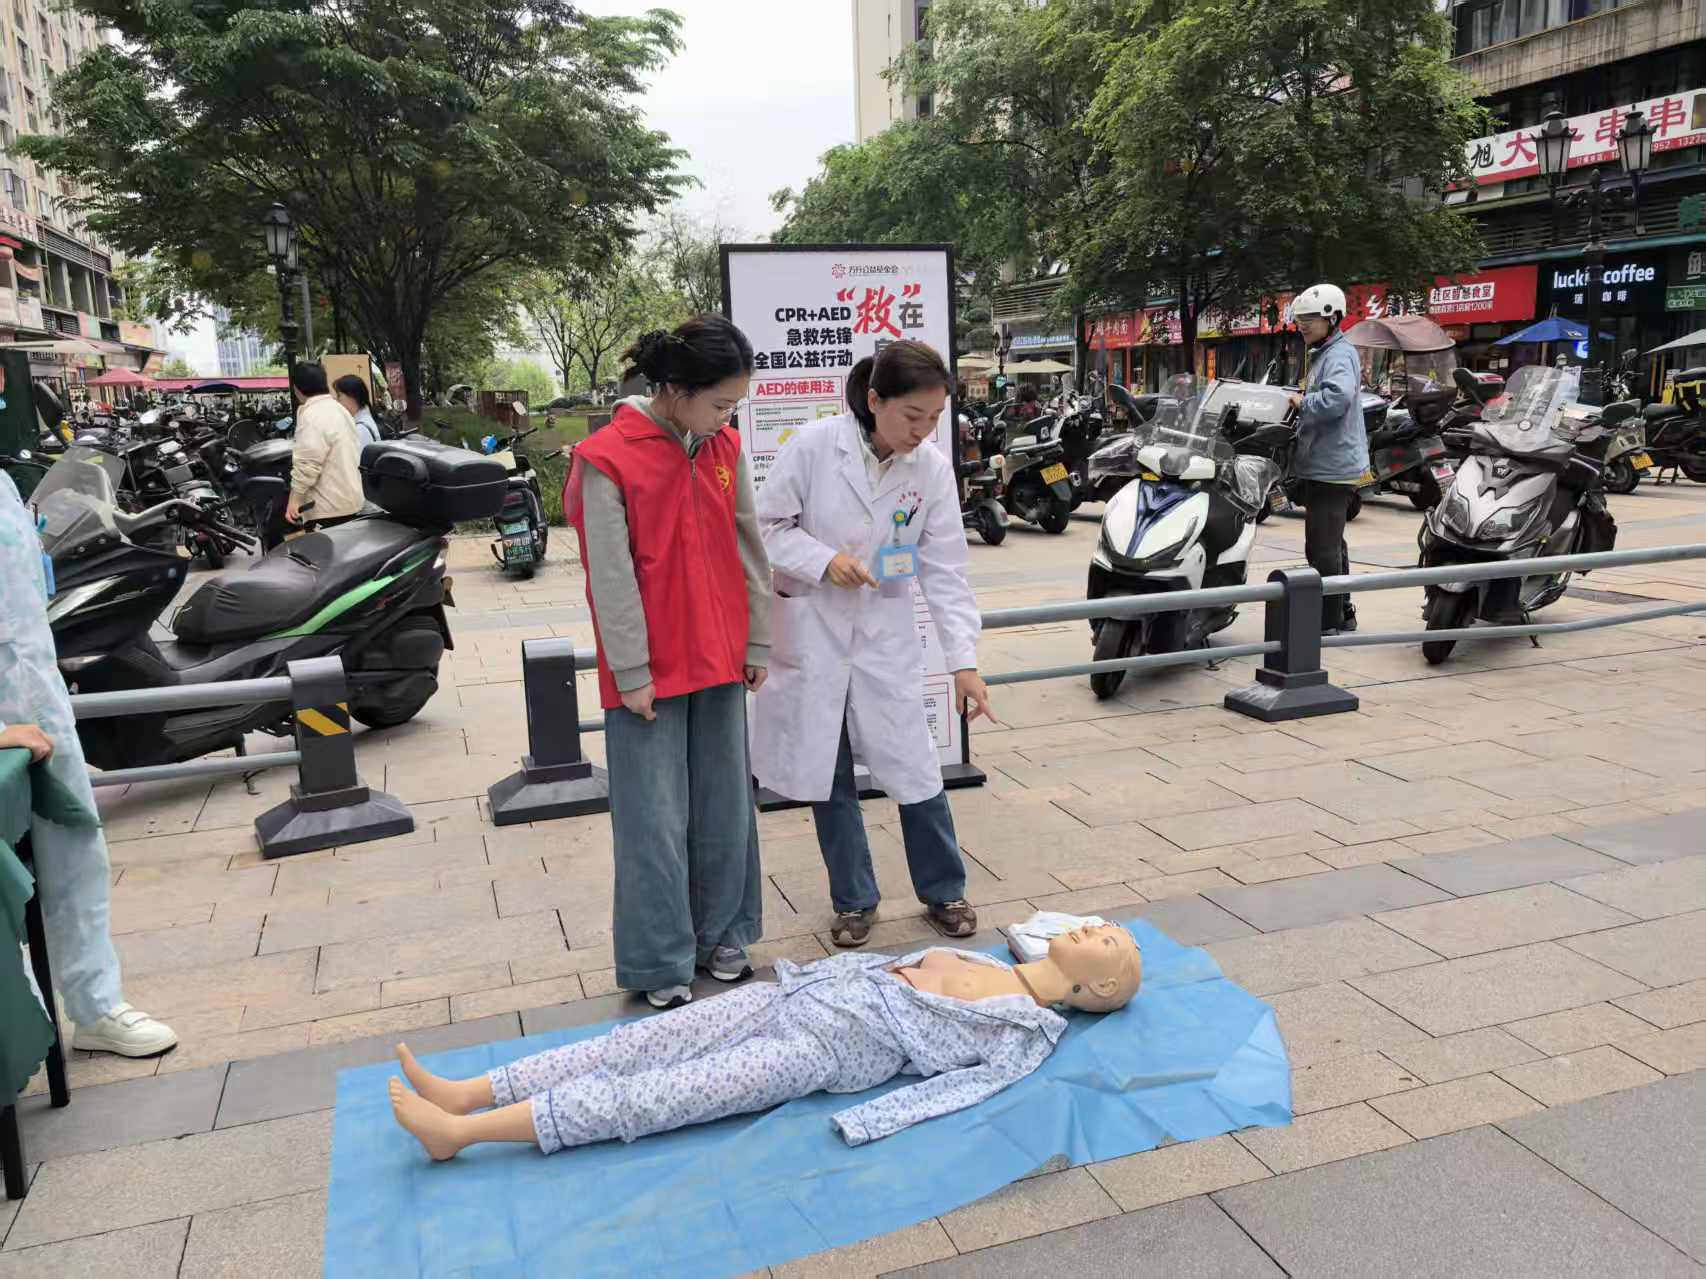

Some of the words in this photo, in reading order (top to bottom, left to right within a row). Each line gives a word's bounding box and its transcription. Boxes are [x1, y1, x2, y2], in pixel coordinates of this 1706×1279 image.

[1471, 98, 1687, 168] 旭大串串
[1553, 269, 1590, 289] lucki
[1603, 263, 1655, 285] coffee
[1574, 290, 1628, 305] 瑞咖啡
[775, 306, 852, 323] CPR+AED
[786, 327, 853, 345] 急救先锋
[754, 348, 853, 370] 全国公益行动
[756, 380, 835, 396] AED的使用法
